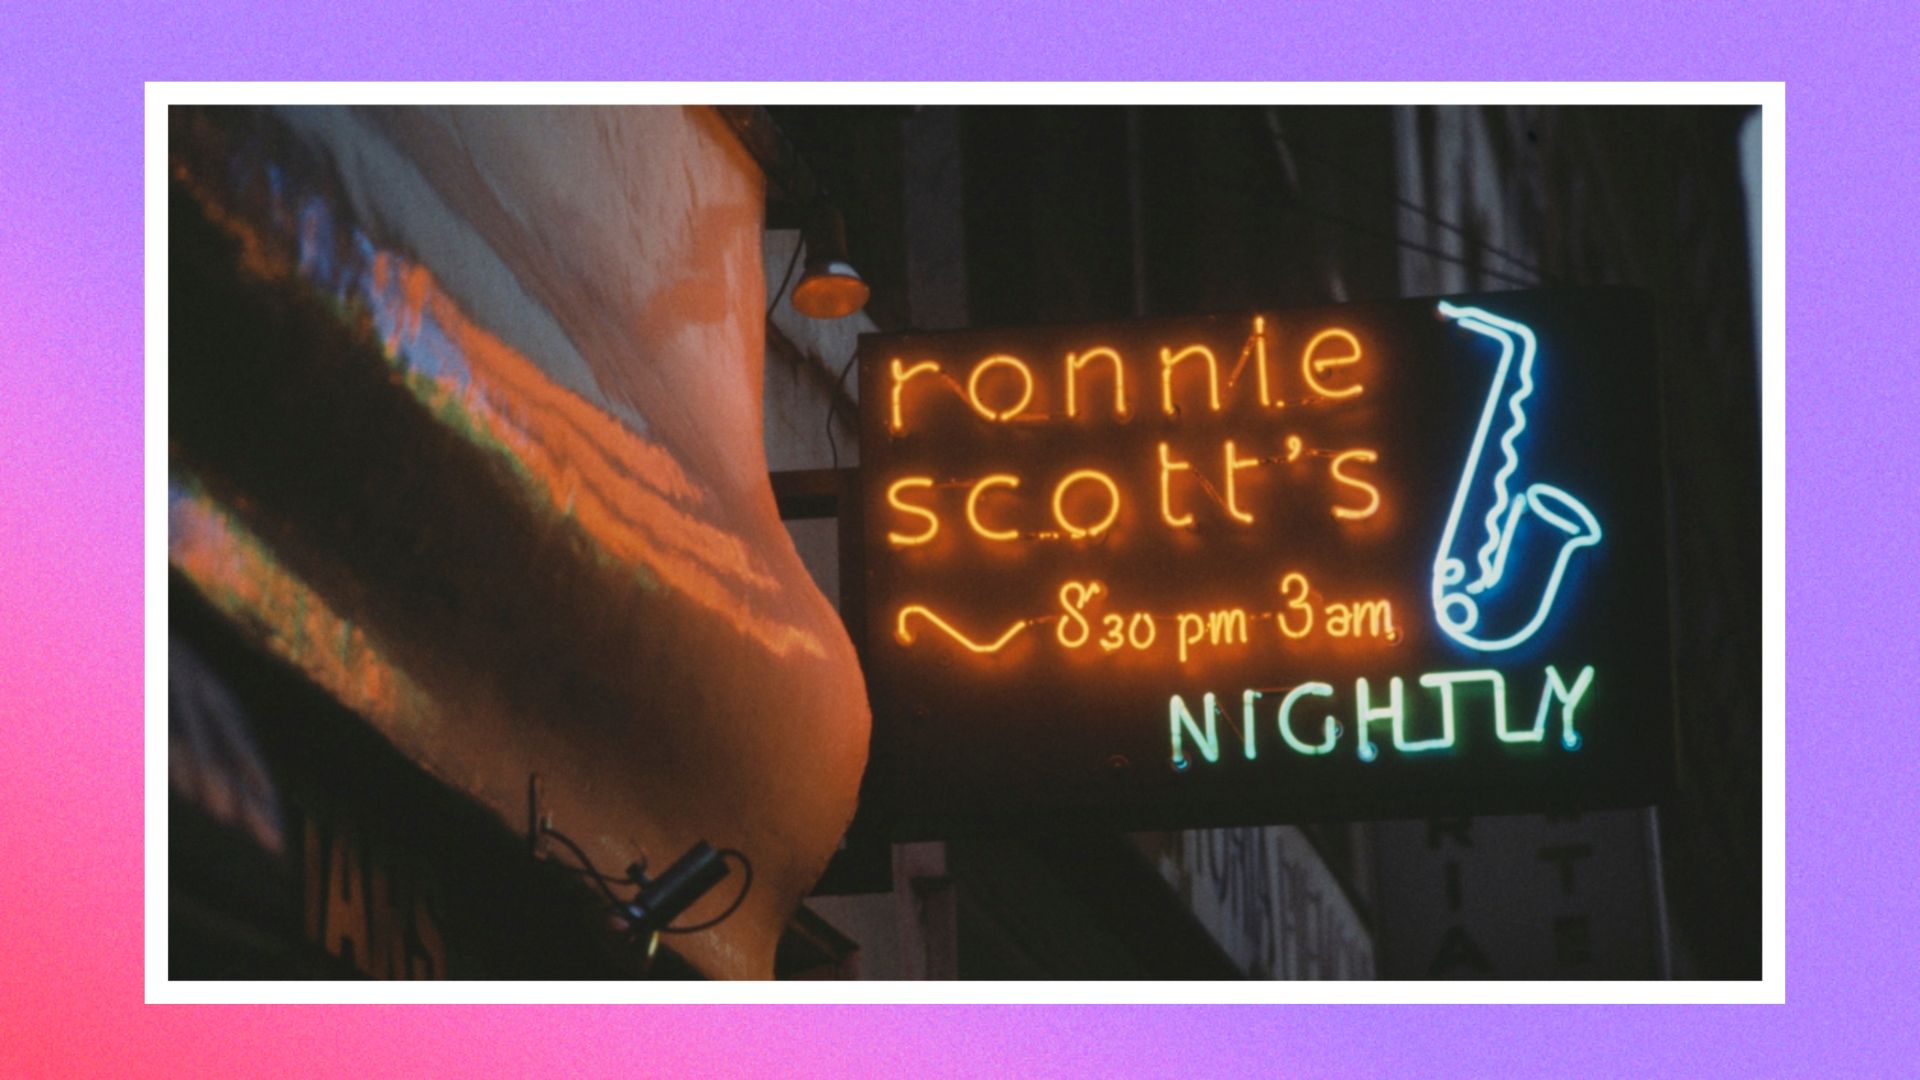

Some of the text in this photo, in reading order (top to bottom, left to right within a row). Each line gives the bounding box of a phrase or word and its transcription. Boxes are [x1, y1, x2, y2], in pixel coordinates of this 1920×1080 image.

[890, 315, 1365, 429] ronnie
[887, 434, 1381, 545] scott's
[1178, 608, 1248, 662] pm
[1169, 664, 1595, 768] NIGHTLY
